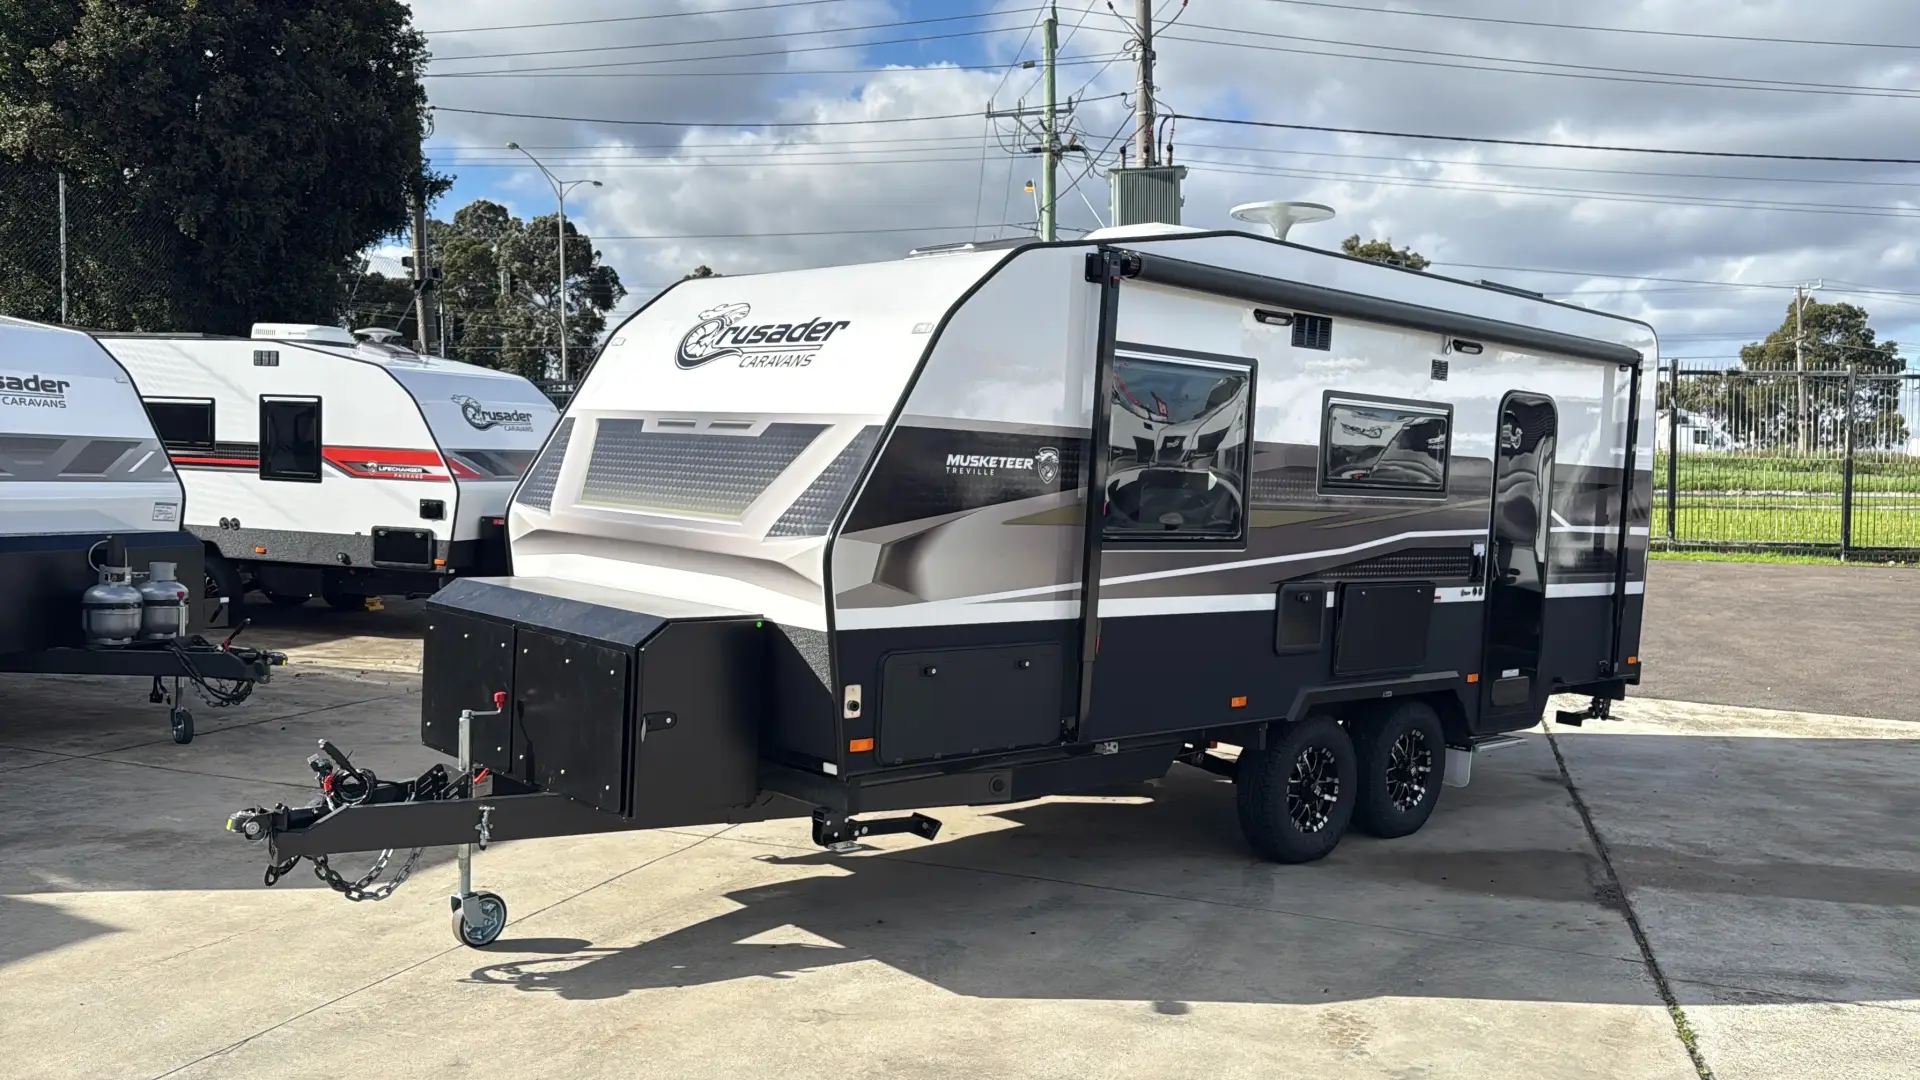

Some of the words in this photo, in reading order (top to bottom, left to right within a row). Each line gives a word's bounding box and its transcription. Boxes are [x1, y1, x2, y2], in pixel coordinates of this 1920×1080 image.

[738, 354, 816, 368] CARAVANS
[2, 396, 67, 409] CARAVANS
[504, 425, 534, 433] CARAVANS
[946, 454, 1034, 470] MUSKETEER
[946, 467, 995, 476] TREVILLE
